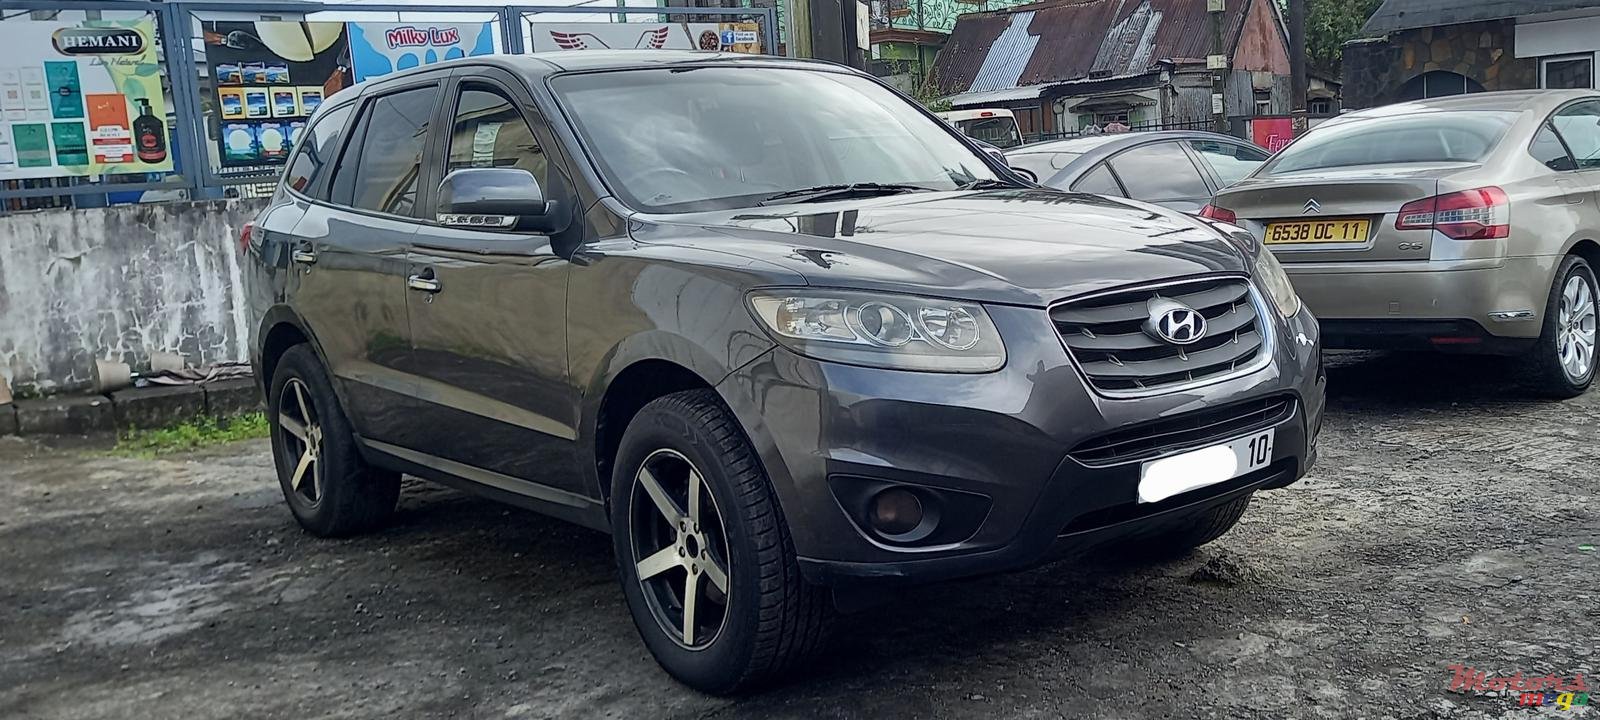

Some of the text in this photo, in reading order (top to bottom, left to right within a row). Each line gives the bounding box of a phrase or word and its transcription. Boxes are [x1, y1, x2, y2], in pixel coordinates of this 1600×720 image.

[63, 35, 139, 48] HEMANI
[386, 27, 460, 49] Milky Lux
[1271, 222, 1309, 241] 6538
[1342, 222, 1360, 240] 11
[1398, 241, 1424, 251] C5
[1248, 434, 1269, 468] 10
